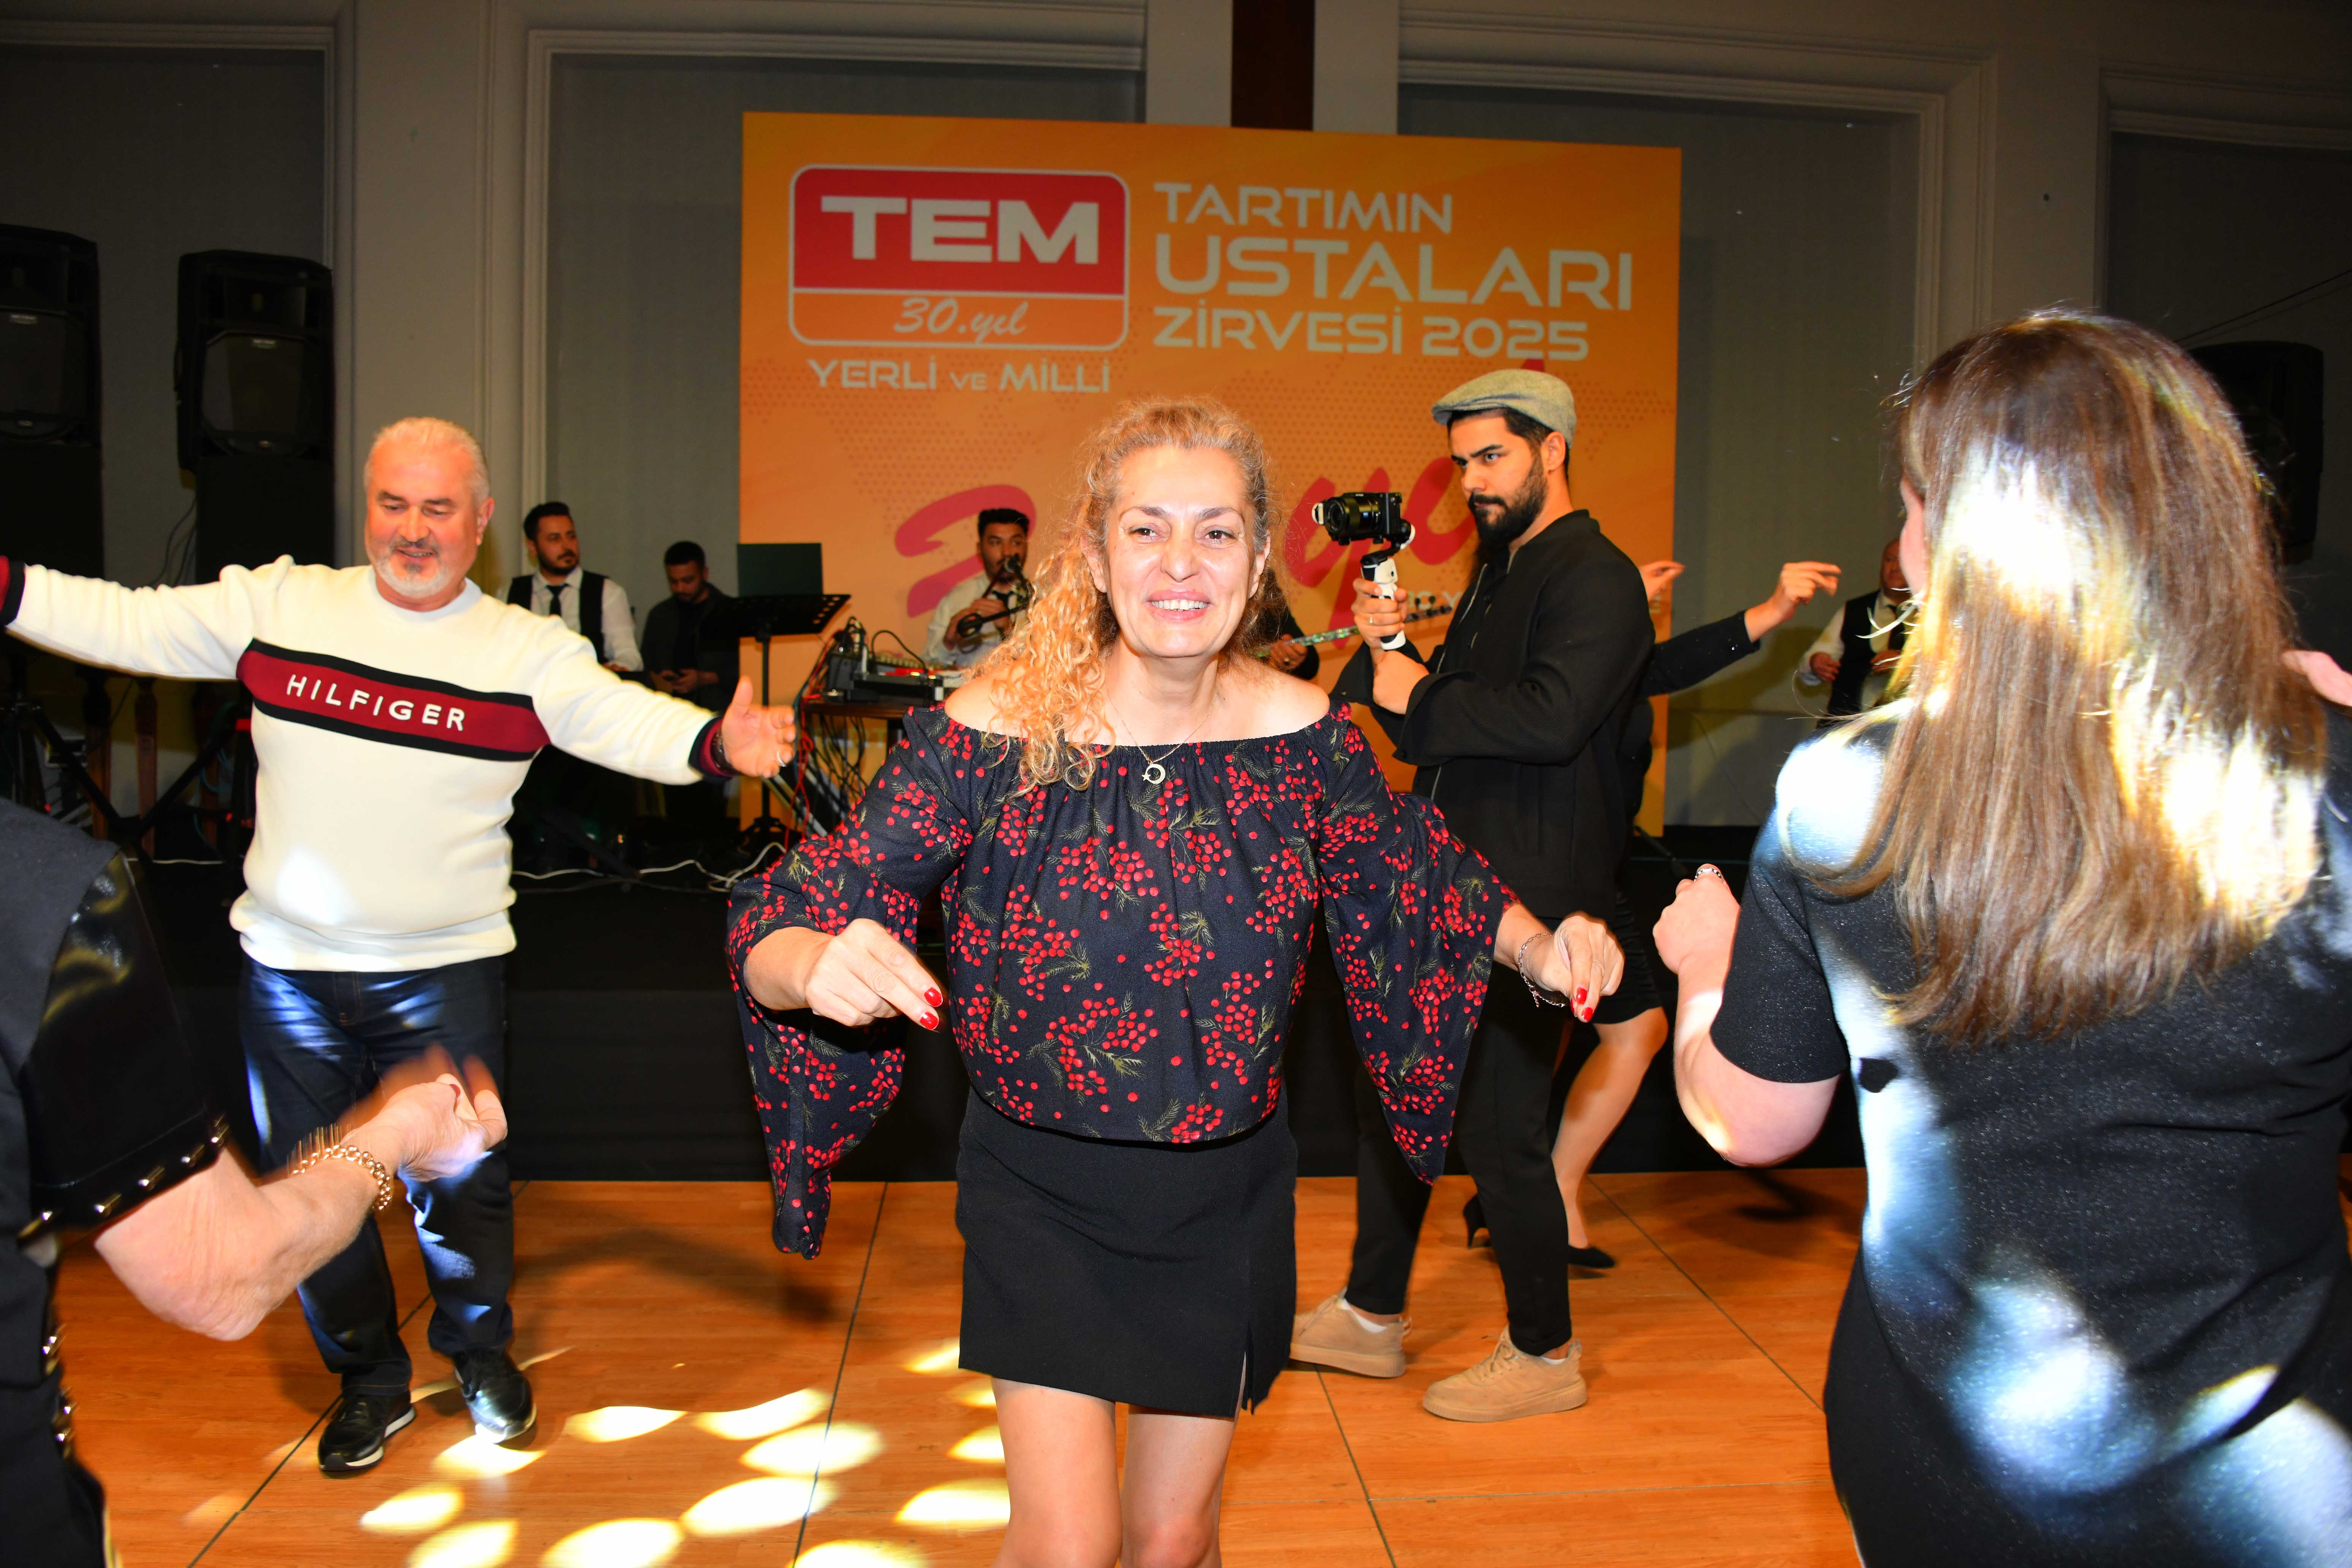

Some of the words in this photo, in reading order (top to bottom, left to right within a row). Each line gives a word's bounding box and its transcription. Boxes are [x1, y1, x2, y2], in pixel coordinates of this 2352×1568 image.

[821, 195, 1099, 264] TEM
[1153, 182, 1452, 234] TARTIMIN
[1156, 234, 1632, 310] USTALARI
[1152, 299, 1403, 355] ZİRVESİ
[1422, 316, 1589, 361] 2025
[808, 356, 937, 389] YERLİ
[999, 358, 1110, 393] MİLLİ
[286, 674, 465, 731] HILFIGER
